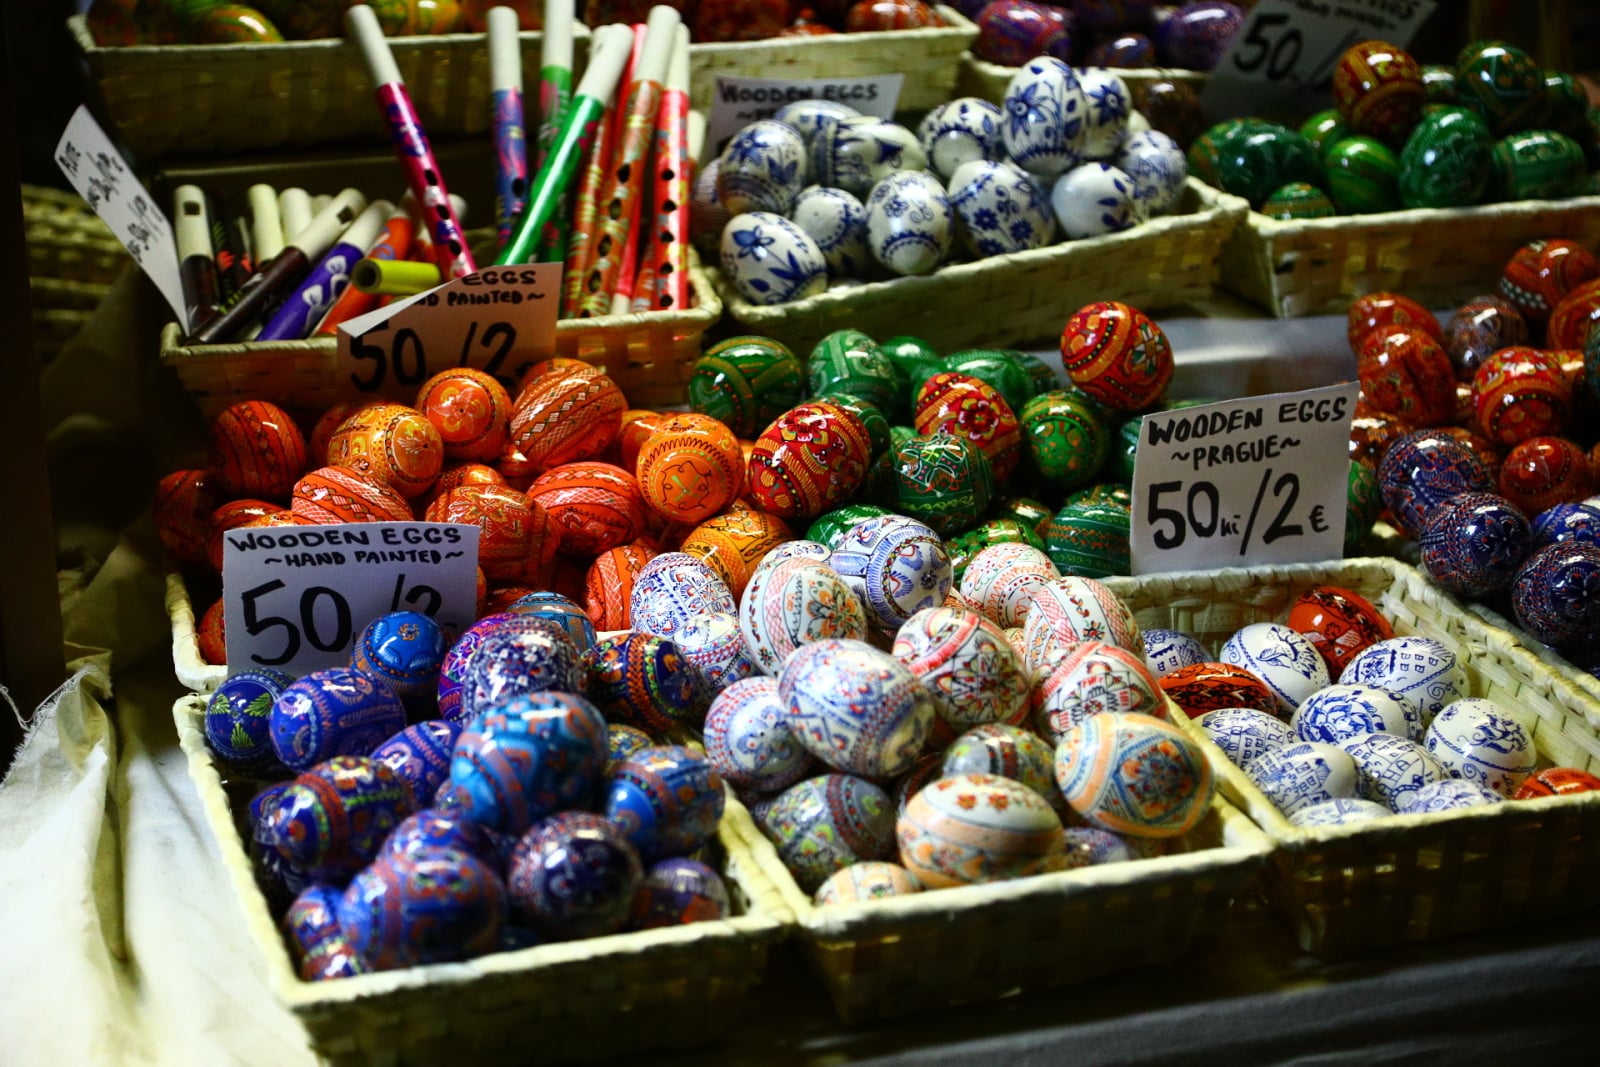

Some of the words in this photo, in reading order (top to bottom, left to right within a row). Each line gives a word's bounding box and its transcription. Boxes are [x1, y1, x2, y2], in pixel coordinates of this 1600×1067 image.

[1234, 13, 1302, 79] 50
[717, 79, 813, 102] WOODEN
[824, 84, 878, 99] EGGS
[461, 270, 536, 286] EGGS
[351, 320, 426, 391] 50
[1148, 408, 1263, 446] WOODEN
[1279, 397, 1347, 423] EGGS
[228, 530, 369, 552] WOODEN
[381, 528, 461, 545] EGGS
[241, 579, 352, 666] 50
